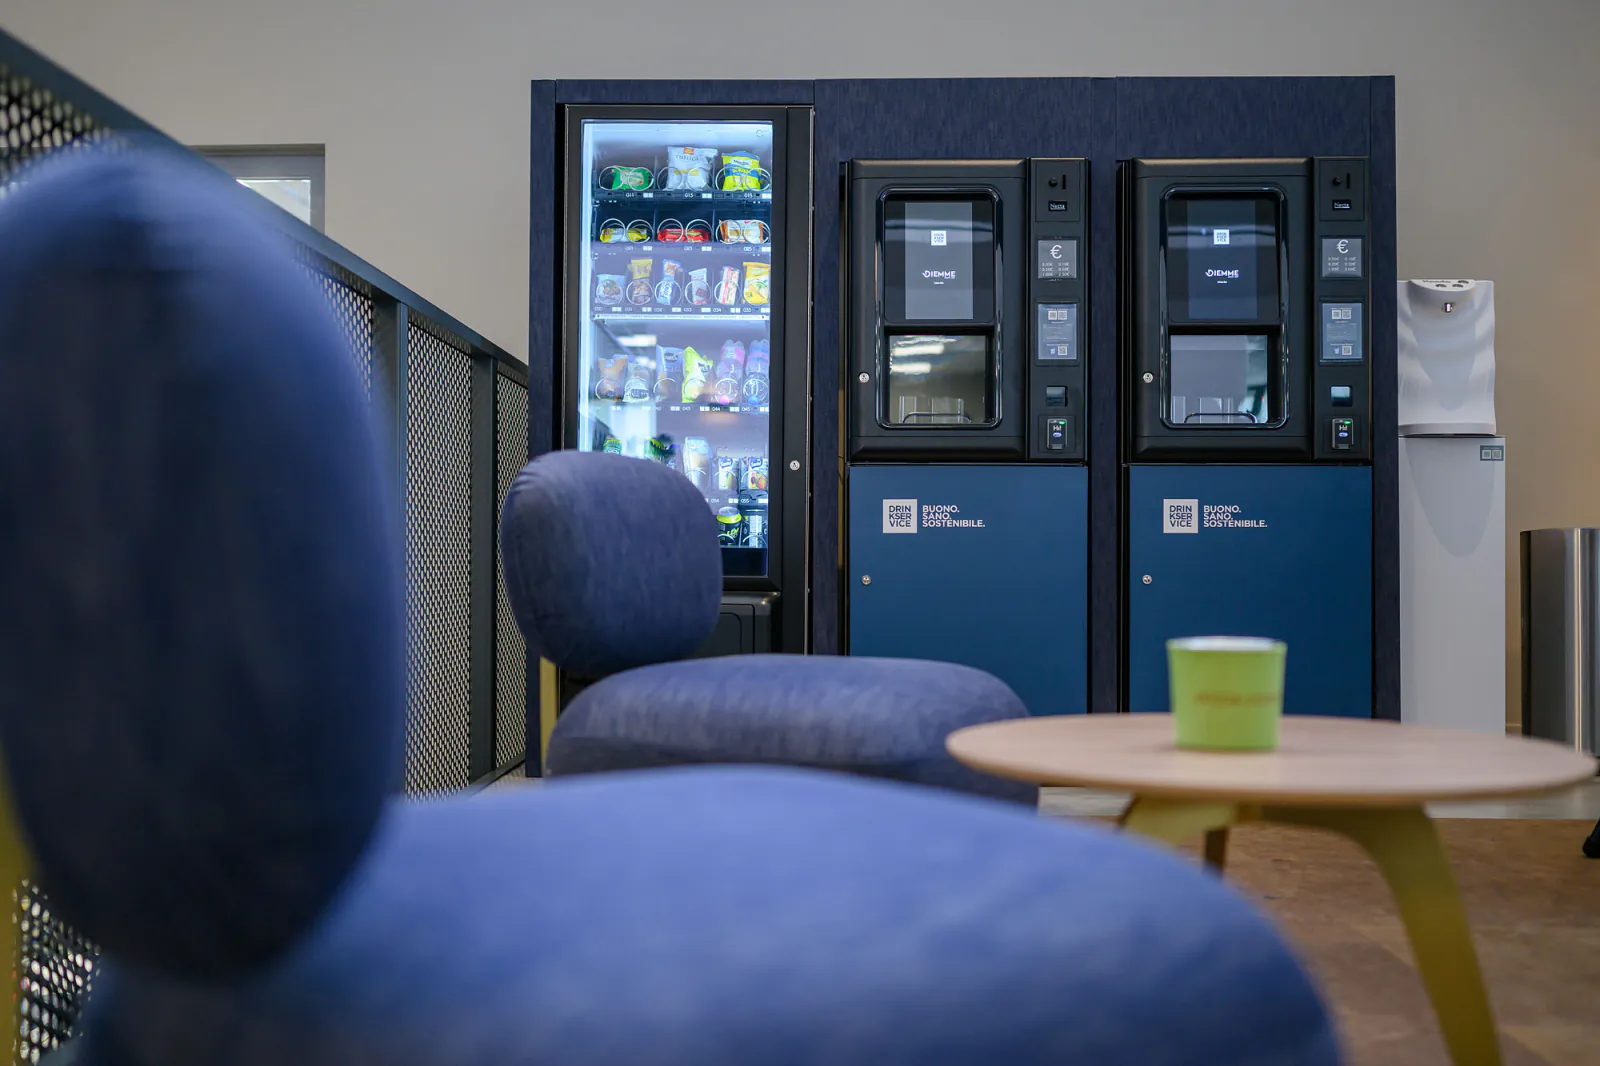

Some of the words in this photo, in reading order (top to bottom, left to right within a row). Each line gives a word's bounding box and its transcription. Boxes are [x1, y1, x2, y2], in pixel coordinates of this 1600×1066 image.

[1336, 239, 1349, 254] €
[1050, 244, 1062, 259] €
[922, 270, 956, 278] DIEMME
[1205, 269, 1239, 277] DIEMME
[889, 505, 911, 513] DRIN
[922, 505, 960, 513] BUONO.
[1169, 505, 1192, 513] DRIN
[1203, 505, 1241, 513] BUONO.
[889, 512, 912, 520] KSER
[922, 512, 952, 520] SANO.
[1169, 512, 1192, 520] KSER
[1203, 512, 1233, 520] SANO.
[922, 519, 985, 528] SOSTENIBILE.
[1203, 519, 1268, 528] SOSTENIBILE.
